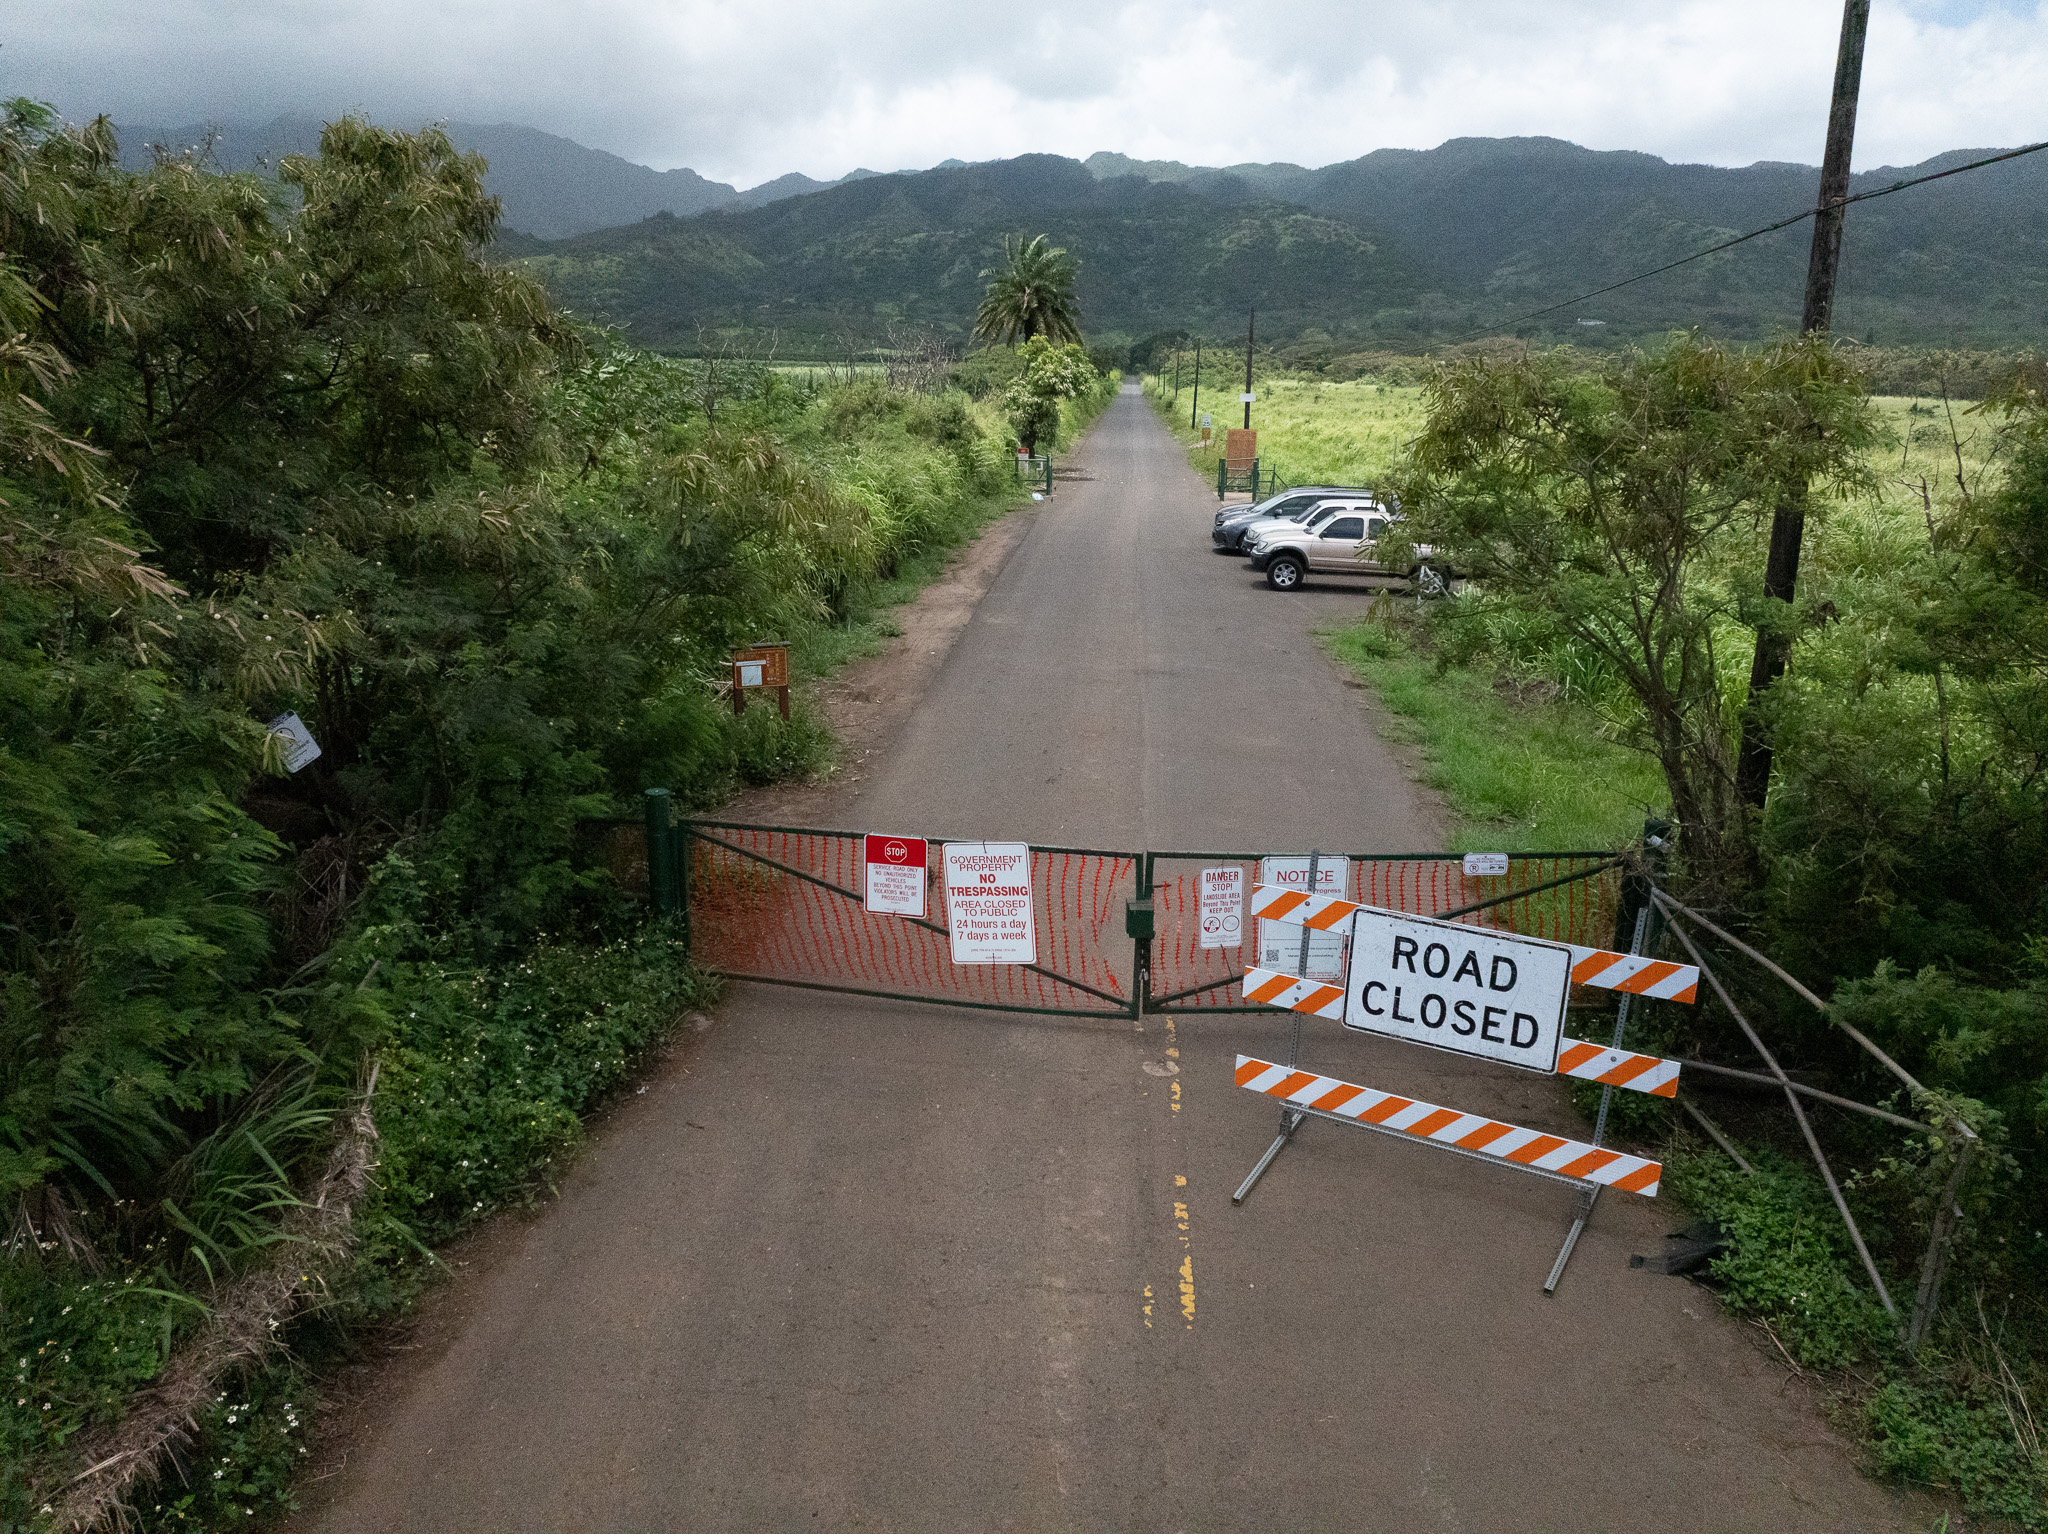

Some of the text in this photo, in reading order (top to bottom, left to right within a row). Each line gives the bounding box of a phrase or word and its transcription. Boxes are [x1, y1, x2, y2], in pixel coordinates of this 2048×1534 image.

[886, 847, 905, 856] STOP
[950, 855, 1022, 864] GOVERNMENT
[979, 873, 996, 884] NO
[1206, 871, 1239, 882] DANGER
[1276, 870, 1334, 882] NOTCE
[949, 885, 1028, 897] TRESPASSING
[1212, 883, 1233, 891] STOP!
[954, 900, 1026, 908] AREA CLOSED
[963, 908, 1018, 917] TO PUBLIC
[956, 919, 1027, 930] 24 hours a day
[958, 931, 1027, 942] 7 days a week
[1391, 935, 1518, 993] ROAD
[1361, 980, 1539, 1049] CLOSED
